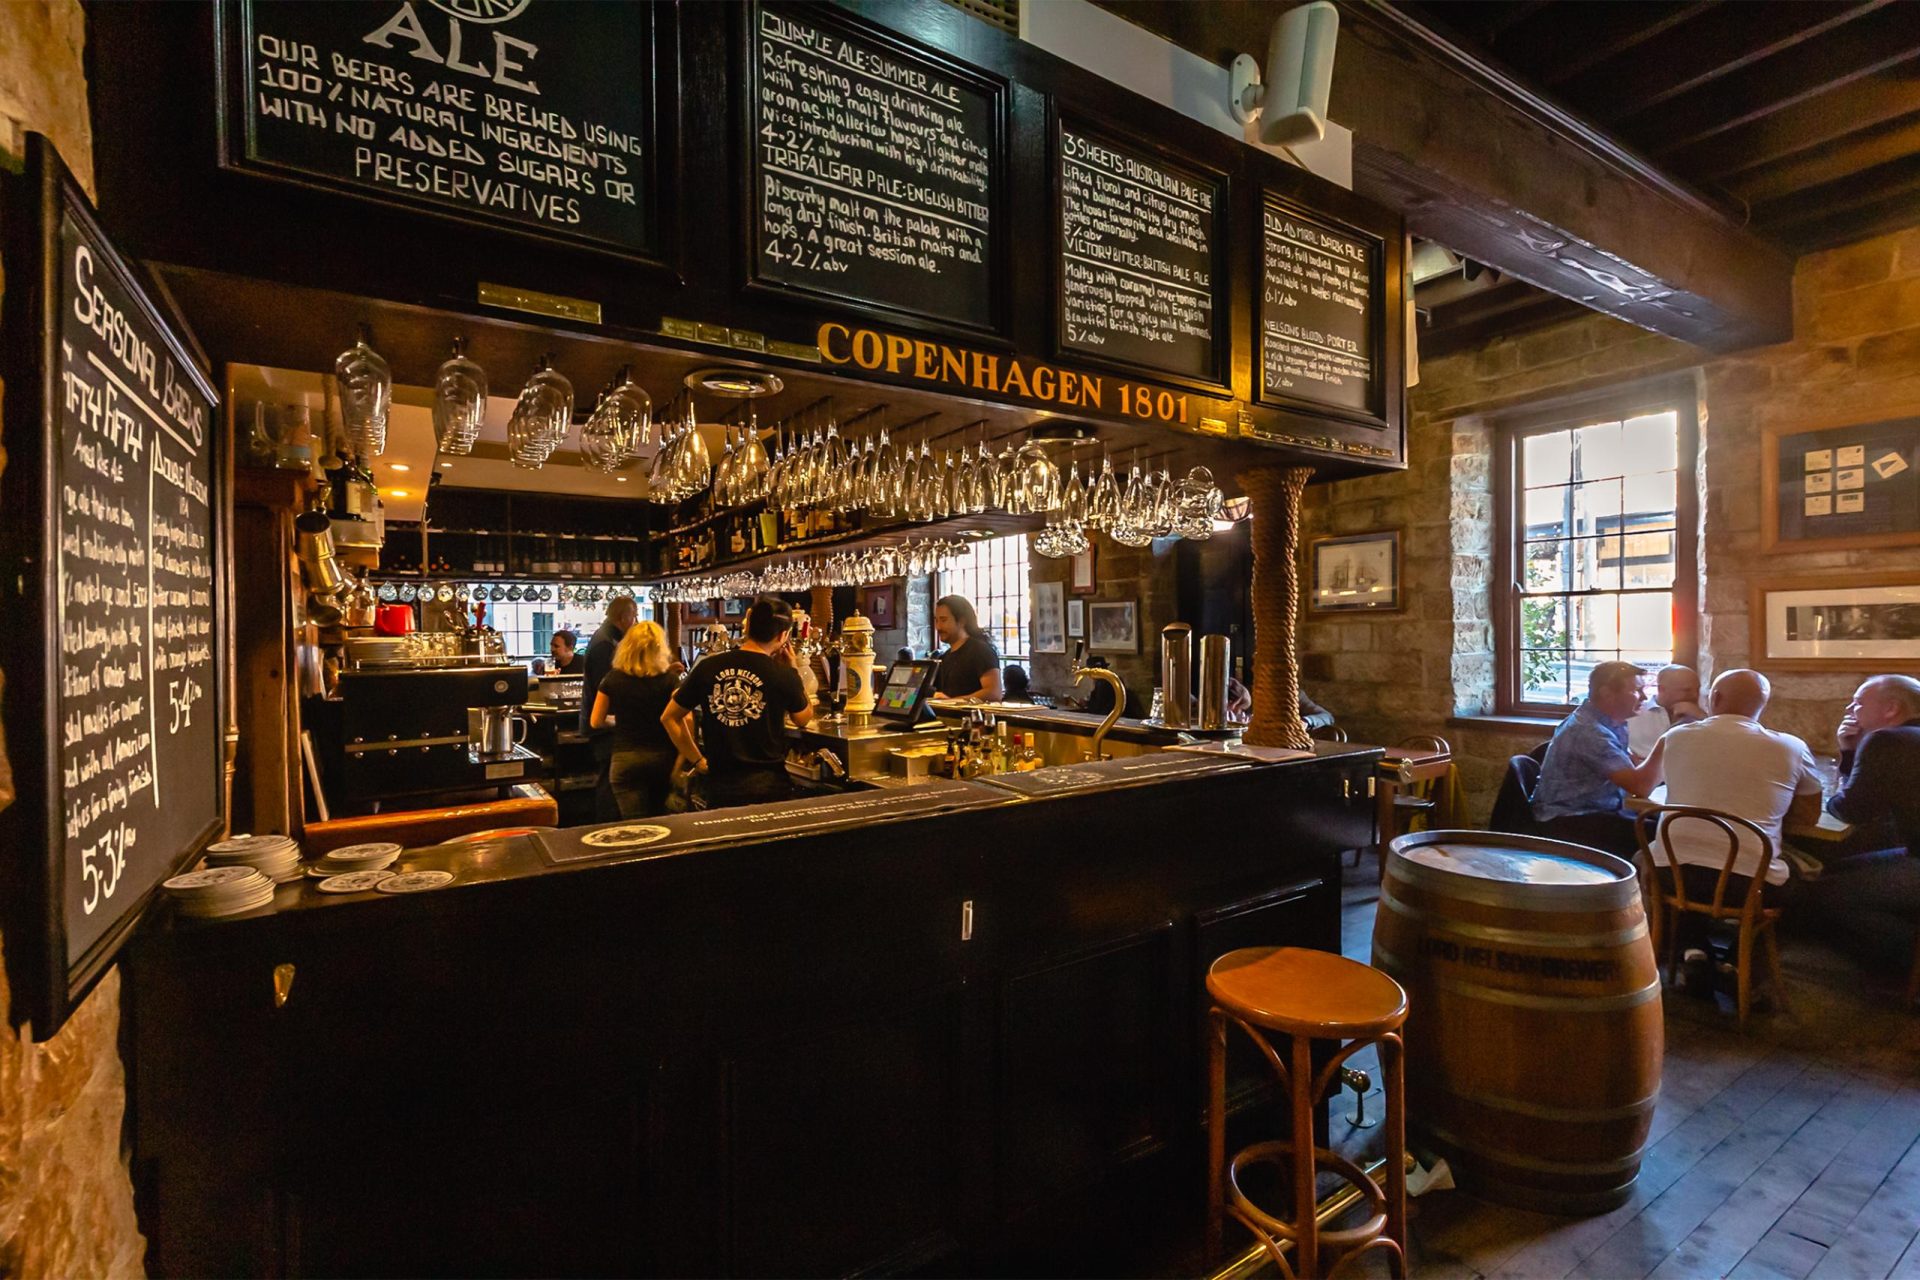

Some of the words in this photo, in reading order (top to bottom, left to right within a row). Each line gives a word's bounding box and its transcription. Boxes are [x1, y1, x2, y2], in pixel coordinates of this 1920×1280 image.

[363, 2, 541, 95] ALE
[761, 11, 832, 54] QUAYLE
[871, 55, 927, 92] SUMMER
[931, 84, 960, 102] ALE
[258, 34, 320, 69] OUR
[332, 52, 415, 95] BEERS
[423, 81, 476, 111] ARE
[485, 95, 576, 139] BREWED
[584, 121, 641, 155] USING
[763, 42, 850, 96] Refreshing
[856, 84, 889, 111] easy
[892, 92, 943, 132] drinking
[947, 117, 964, 134] ale
[258, 62, 343, 101] 100%
[352, 89, 474, 137] NATURAL
[482, 121, 627, 175] INGREDIENTS
[763, 107, 794, 126] Nice
[800, 116, 873, 150] introduction
[876, 142, 901, 160] with
[905, 151, 928, 173] high
[801, 84, 841, 107] subtle
[847, 99, 878, 121] malt
[880, 106, 936, 140] flavours
[941, 133, 959, 149] and
[260, 92, 327, 128] WITH
[336, 112, 376, 140] NO
[389, 129, 485, 165] ADDED
[499, 152, 596, 194] SUGARS
[605, 180, 636, 205] OR
[818, 142, 841, 158] abv
[927, 142, 966, 166] lighter
[1064, 133, 1076, 155] 3
[1126, 159, 1179, 195] AUSTRALIAN
[1181, 182, 1198, 203] PALE
[1200, 192, 1211, 208] ALE
[355, 147, 579, 223] PRESERVATIVES
[763, 145, 862, 186] TRAFALGAR
[907, 184, 955, 211] ENGLISH
[957, 198, 989, 222] BITTER
[1063, 161, 1092, 186] Lifted
[1096, 175, 1120, 195] floral
[1124, 189, 1140, 202] and
[1143, 193, 1167, 212] citrus
[765, 175, 825, 209] Biscuity
[829, 196, 860, 218] malt
[863, 205, 879, 222] on
[884, 208, 902, 228] the
[906, 216, 941, 239] palate
[947, 229, 971, 246] with
[975, 238, 982, 249] a
[765, 200, 793, 224] long
[797, 207, 821, 228] dry
[873, 228, 916, 248] British
[921, 238, 954, 257] malts
[959, 248, 982, 263] and
[1063, 196, 1080, 211] The
[1082, 201, 1107, 218] house
[1148, 225, 1163, 238] and
[1063, 209, 1091, 225] bottles
[1083, 189, 1089, 199] a
[1134, 206, 1160, 226] malty
[1162, 215, 1177, 234] dry
[1083, 228, 1102, 241] abv
[807, 229, 819, 243] A
[824, 235, 863, 256] great
[868, 244, 916, 265] session
[1064, 236, 1112, 260] VICTORY
[1143, 256, 1171, 274] BRITISH
[1173, 265, 1191, 281] PALE
[1194, 271, 1209, 286] ALE
[1265, 212, 1282, 233] OLD
[1320, 234, 1344, 254] DARK
[1345, 243, 1364, 262] ALE
[823, 258, 848, 272] abv
[1065, 260, 1093, 283] Malty
[1096, 270, 1117, 287] with
[1120, 278, 1155, 296] caramel
[1065, 279, 1113, 303] generously
[1115, 289, 1145, 308] hopped
[1150, 301, 1169, 315] with
[1172, 303, 1204, 322] English
[1065, 296, 1107, 316] varieties
[1110, 306, 1124, 318] for
[1127, 311, 1134, 321] a
[1136, 312, 1158, 328] spicy
[1160, 317, 1178, 331] mild
[1065, 308, 1107, 328] Beautiful
[1110, 318, 1139, 335] British
[1142, 327, 1160, 341] style
[74, 245, 160, 400] SEASONAL
[162, 355, 203, 447] BREWS
[1088, 332, 1105, 344] abv
[1326, 334, 1358, 352] PORTER
[817, 321, 1102, 409] COPENHAGEN
[1118, 384, 1188, 424] 1801
[103, 381, 143, 462] FIFTY
[716, 668, 735, 681] LORD
[736, 668, 764, 687] NELSON
